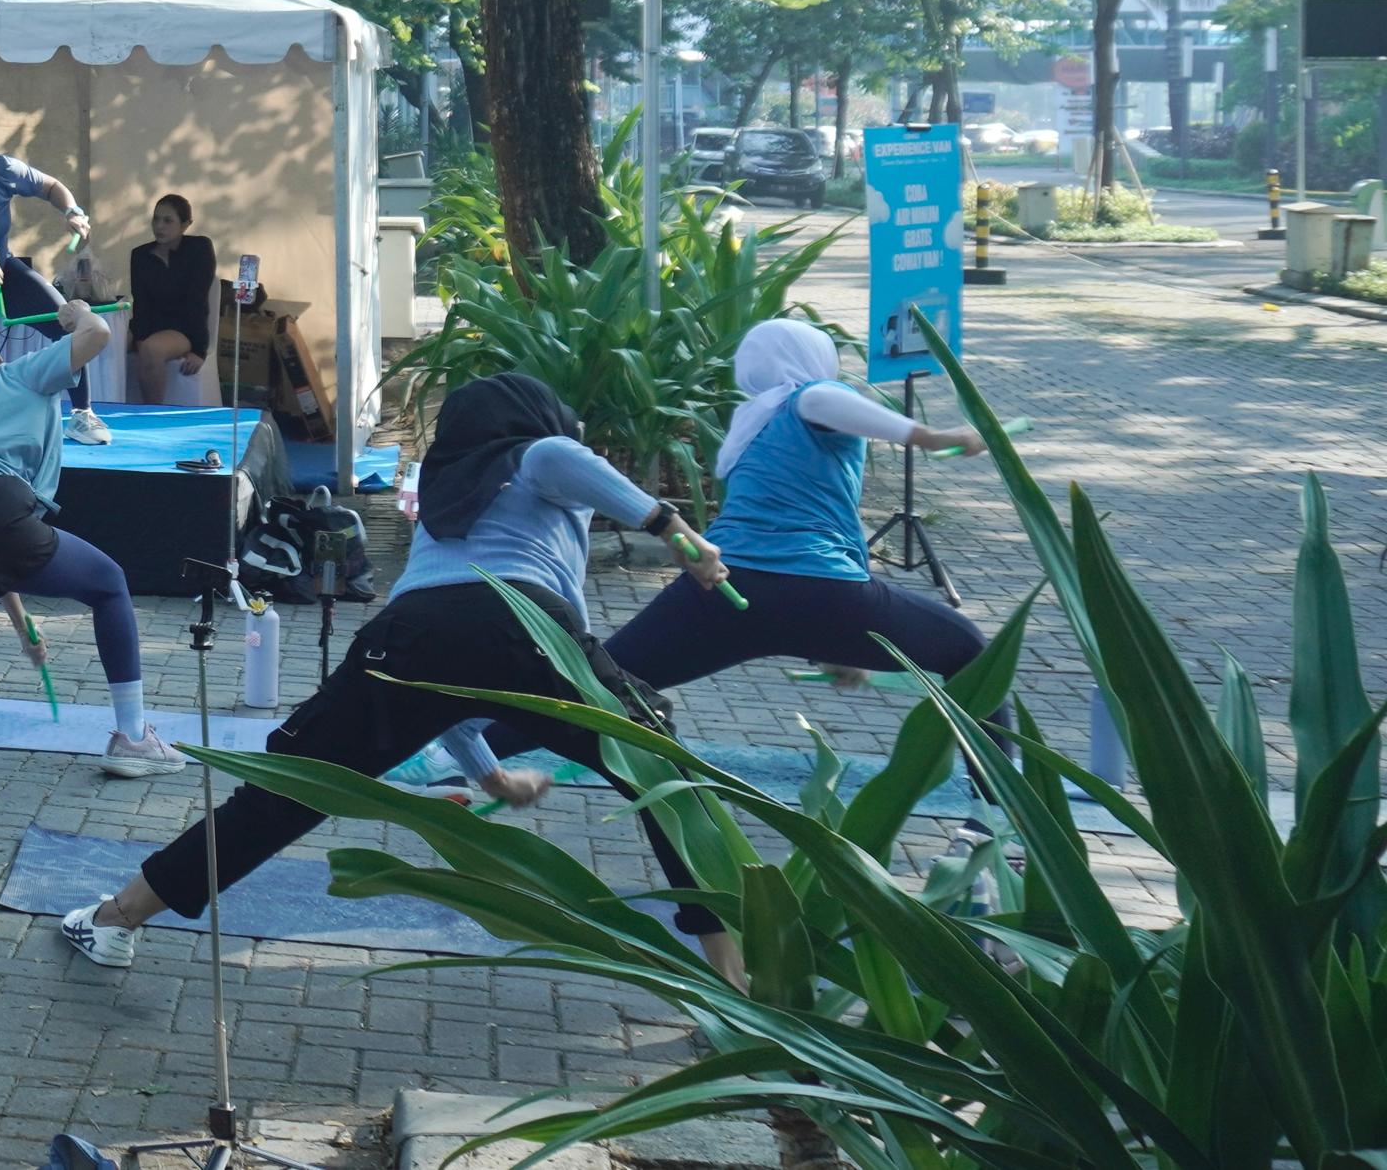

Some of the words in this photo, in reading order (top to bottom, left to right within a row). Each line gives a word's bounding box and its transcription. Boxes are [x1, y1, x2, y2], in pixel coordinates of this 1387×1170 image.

[874, 141, 931, 157] EXPERIENCE
[932, 140, 952, 153] VAN
[904, 228, 933, 248] GRATIS
[893, 252, 922, 272] COWAY
